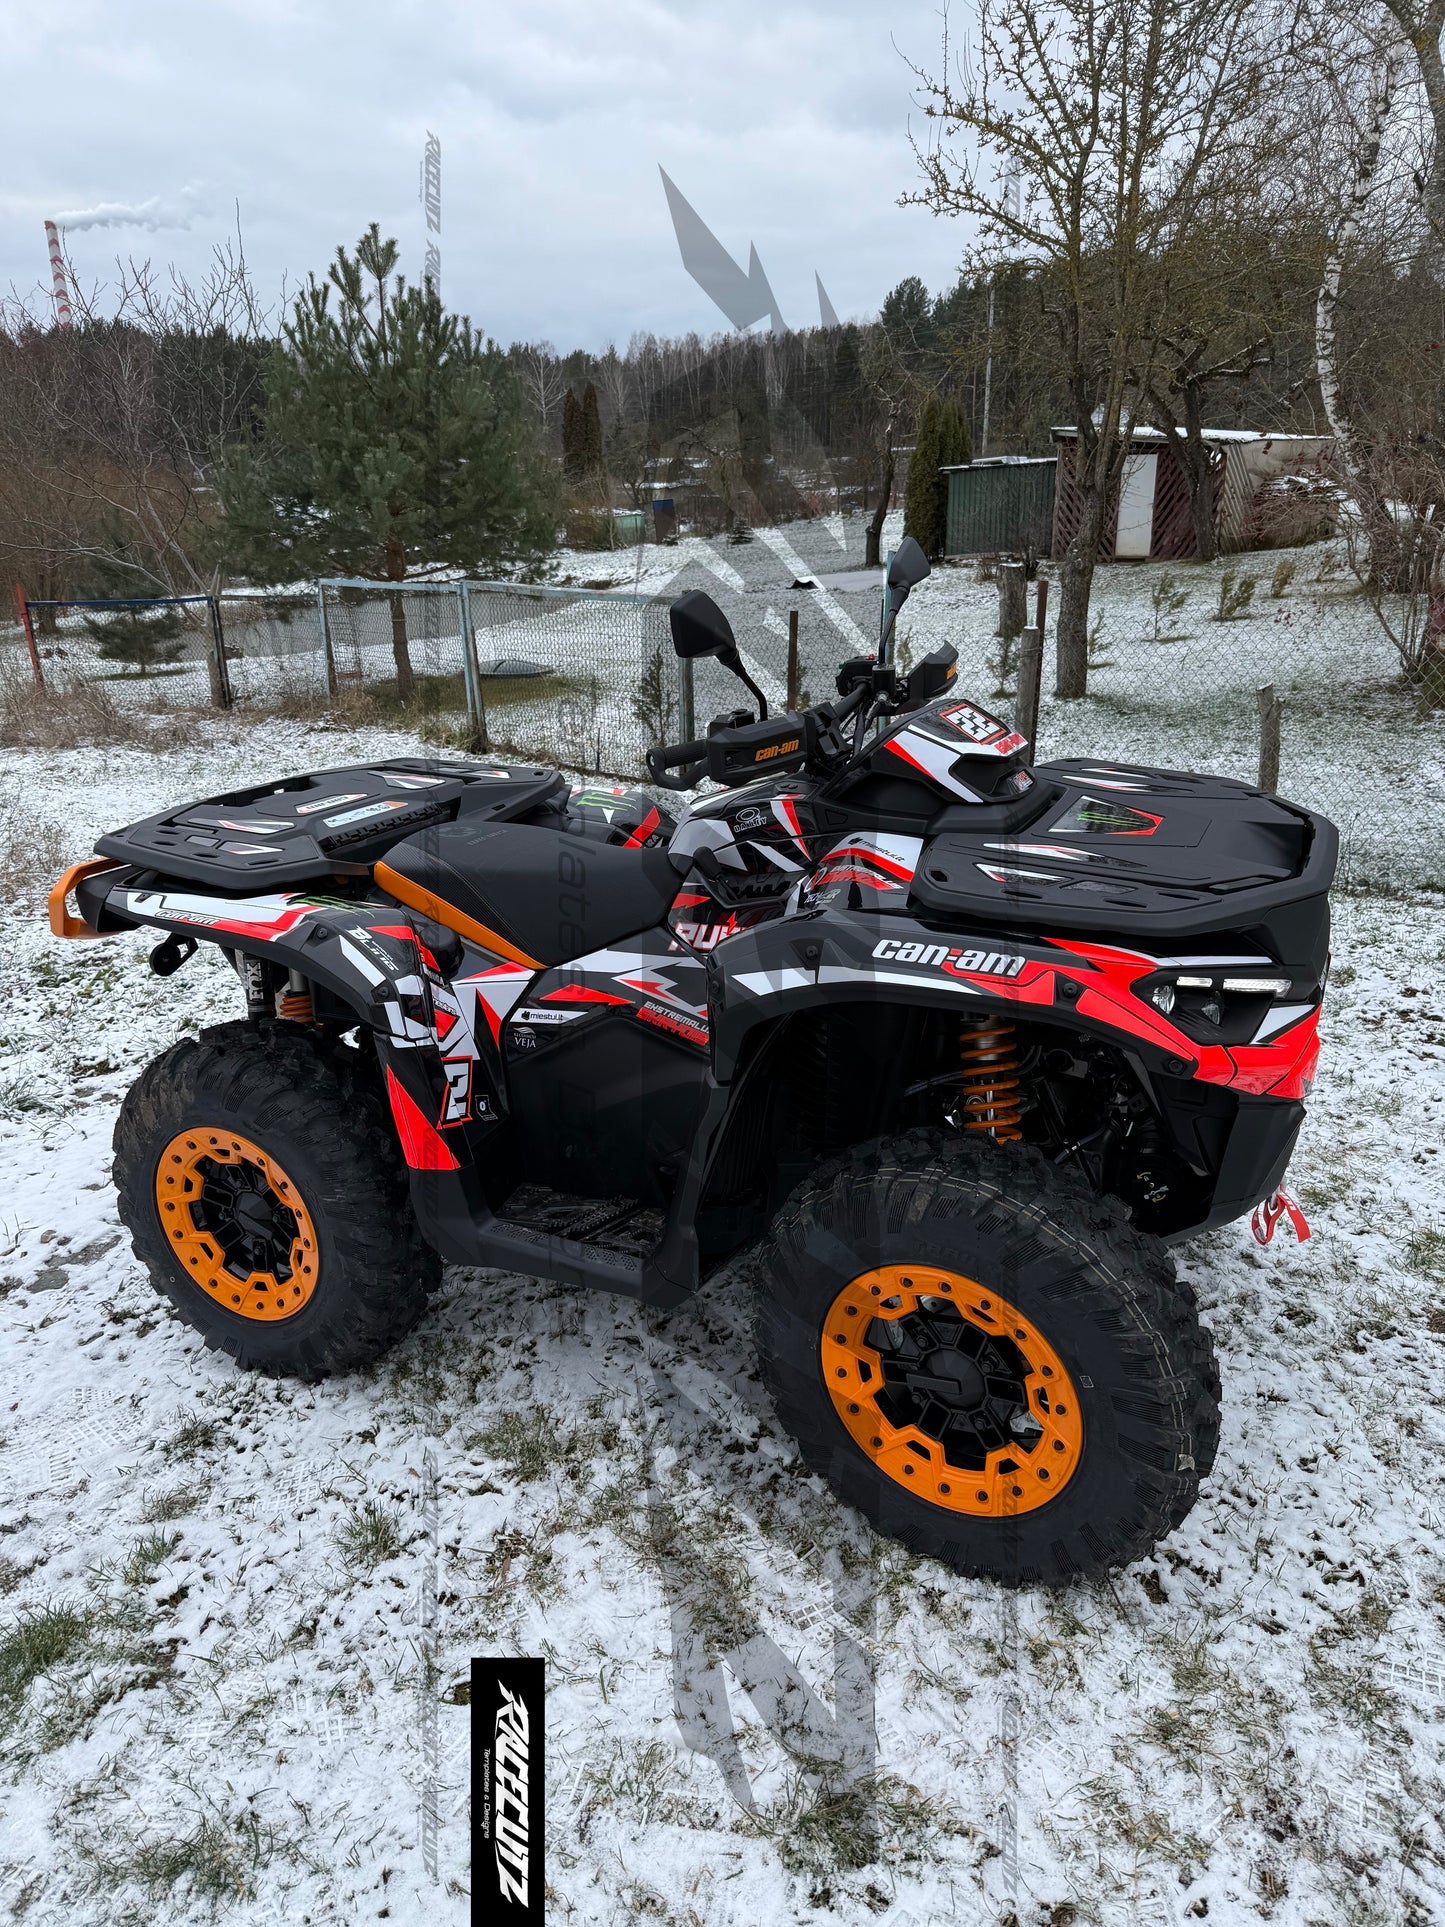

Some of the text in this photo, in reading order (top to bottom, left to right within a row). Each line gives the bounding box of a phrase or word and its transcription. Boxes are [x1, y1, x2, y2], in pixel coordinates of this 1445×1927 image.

[754, 739, 800, 762] can-am
[154, 910, 220, 926] can-am
[871, 939, 1026, 977] can-am
[244, 959, 264, 1001] FOX
[514, 1037, 537, 1049] VEJA
